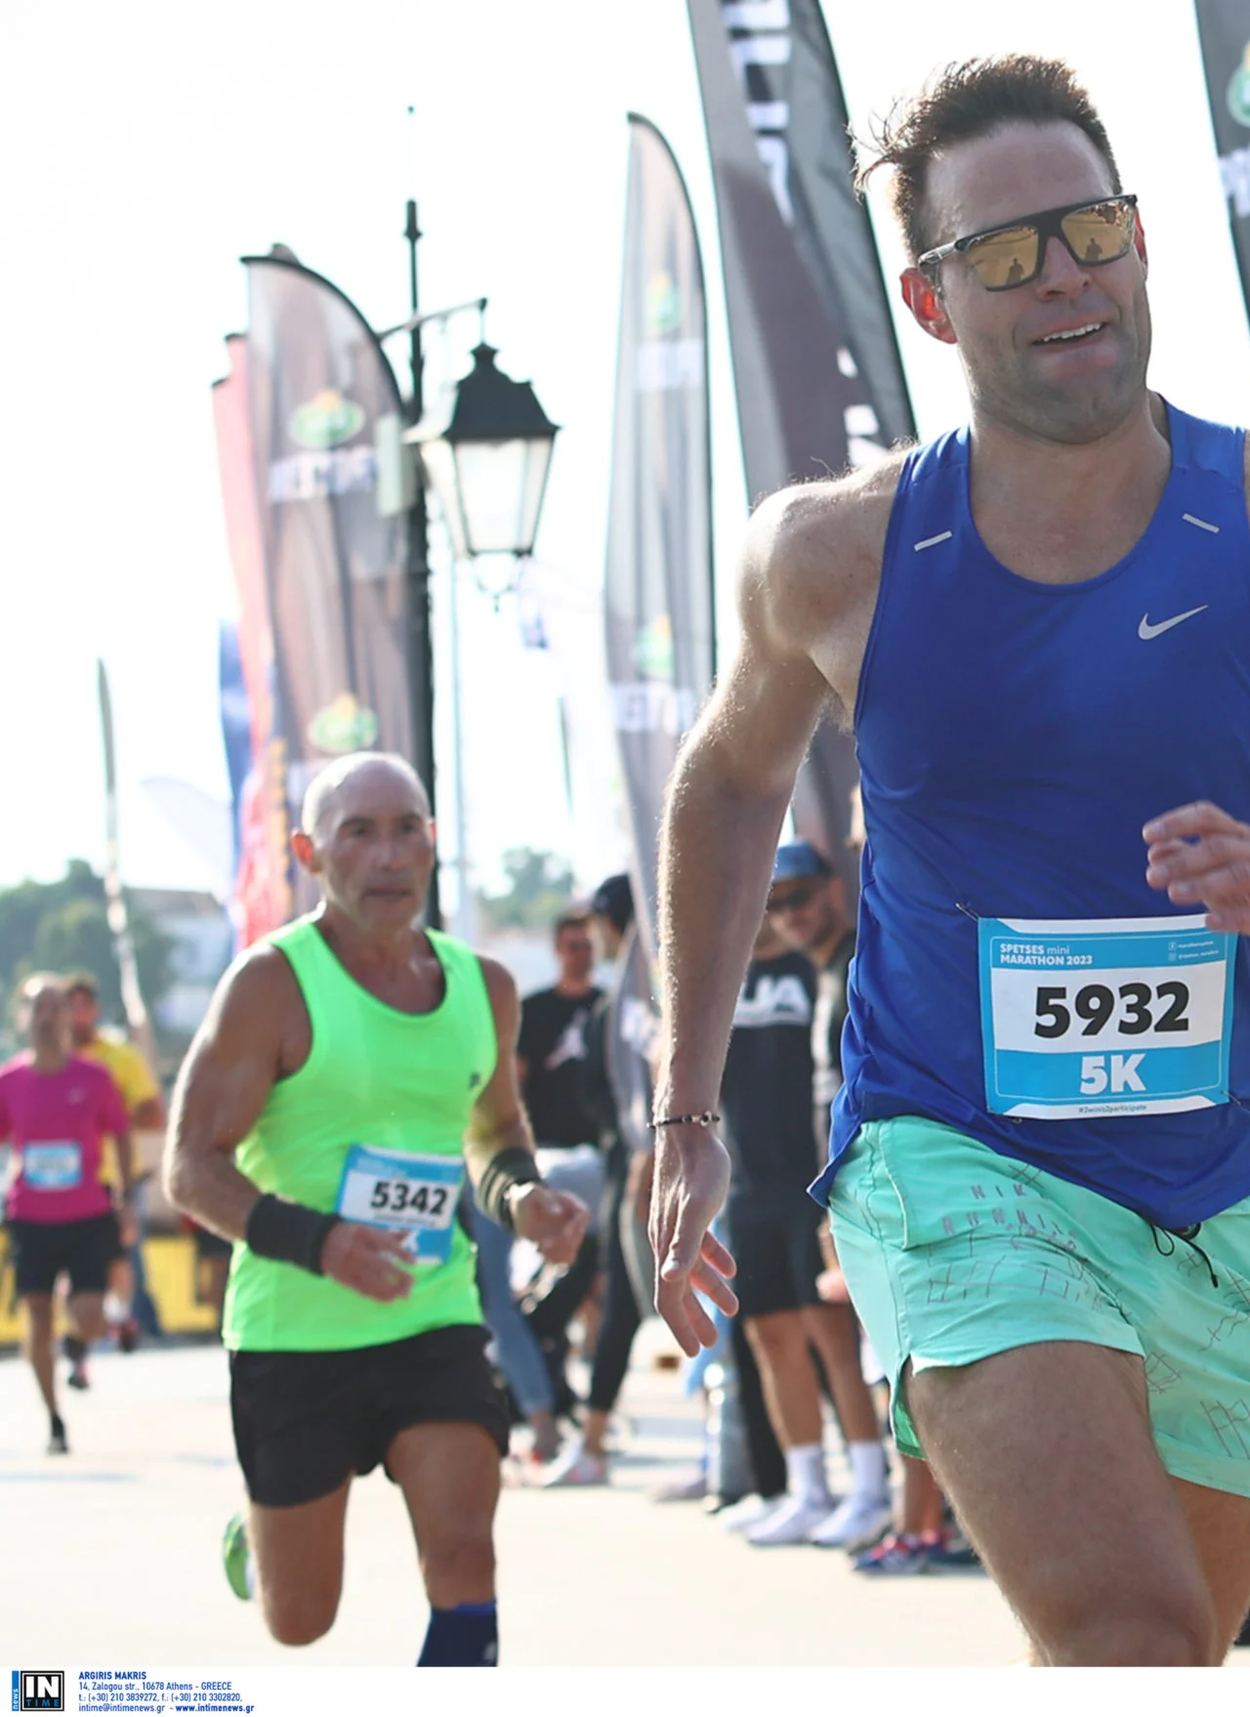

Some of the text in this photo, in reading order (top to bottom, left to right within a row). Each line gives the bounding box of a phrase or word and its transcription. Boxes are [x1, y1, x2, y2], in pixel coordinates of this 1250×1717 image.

[1000, 943, 1070, 955] SPETSES mini
[1000, 954, 1093, 966] MARATHON 2023
[1034, 980, 1189, 1039] 5932
[1080, 1053, 1146, 1095] 5K
[371, 1180, 448, 1216] 5342
[970, 1183, 1034, 1200] NIK
